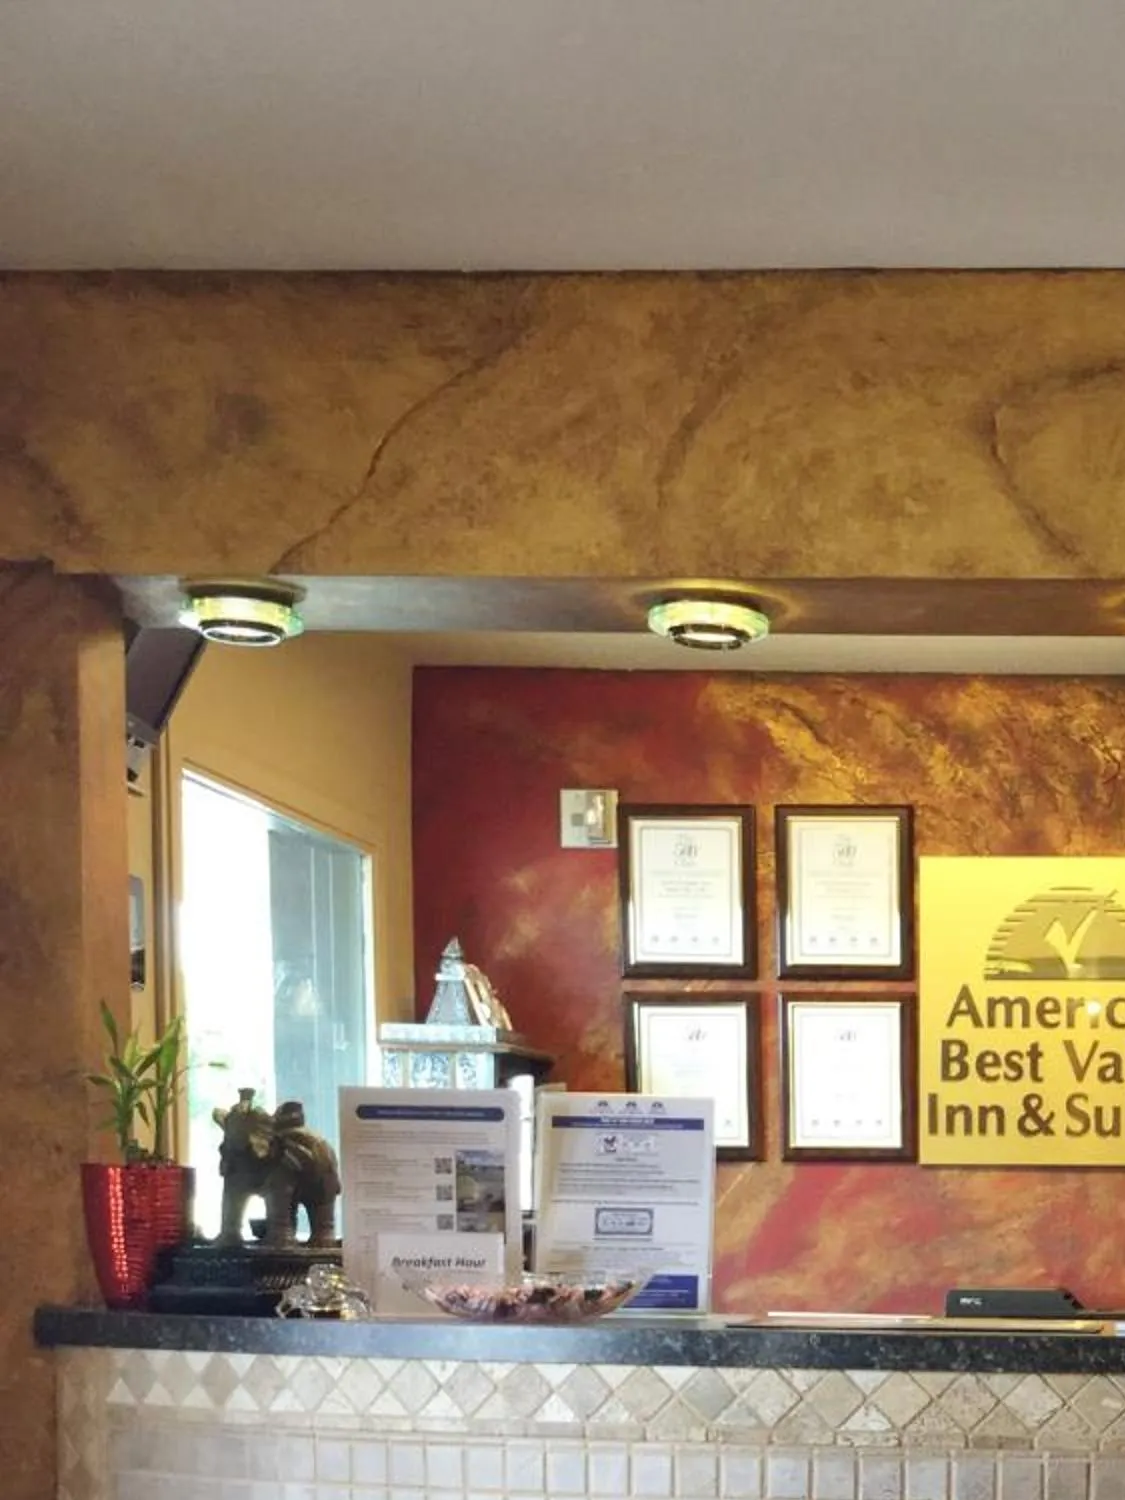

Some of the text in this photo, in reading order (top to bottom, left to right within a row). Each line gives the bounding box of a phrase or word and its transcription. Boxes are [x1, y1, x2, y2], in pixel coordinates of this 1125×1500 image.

[940, 1039, 1044, 1083] Best
[927, 1092, 1005, 1137] Inn
[1016, 1092, 1055, 1138] &
[390, 1256, 486, 1269] Breakfast Hour
